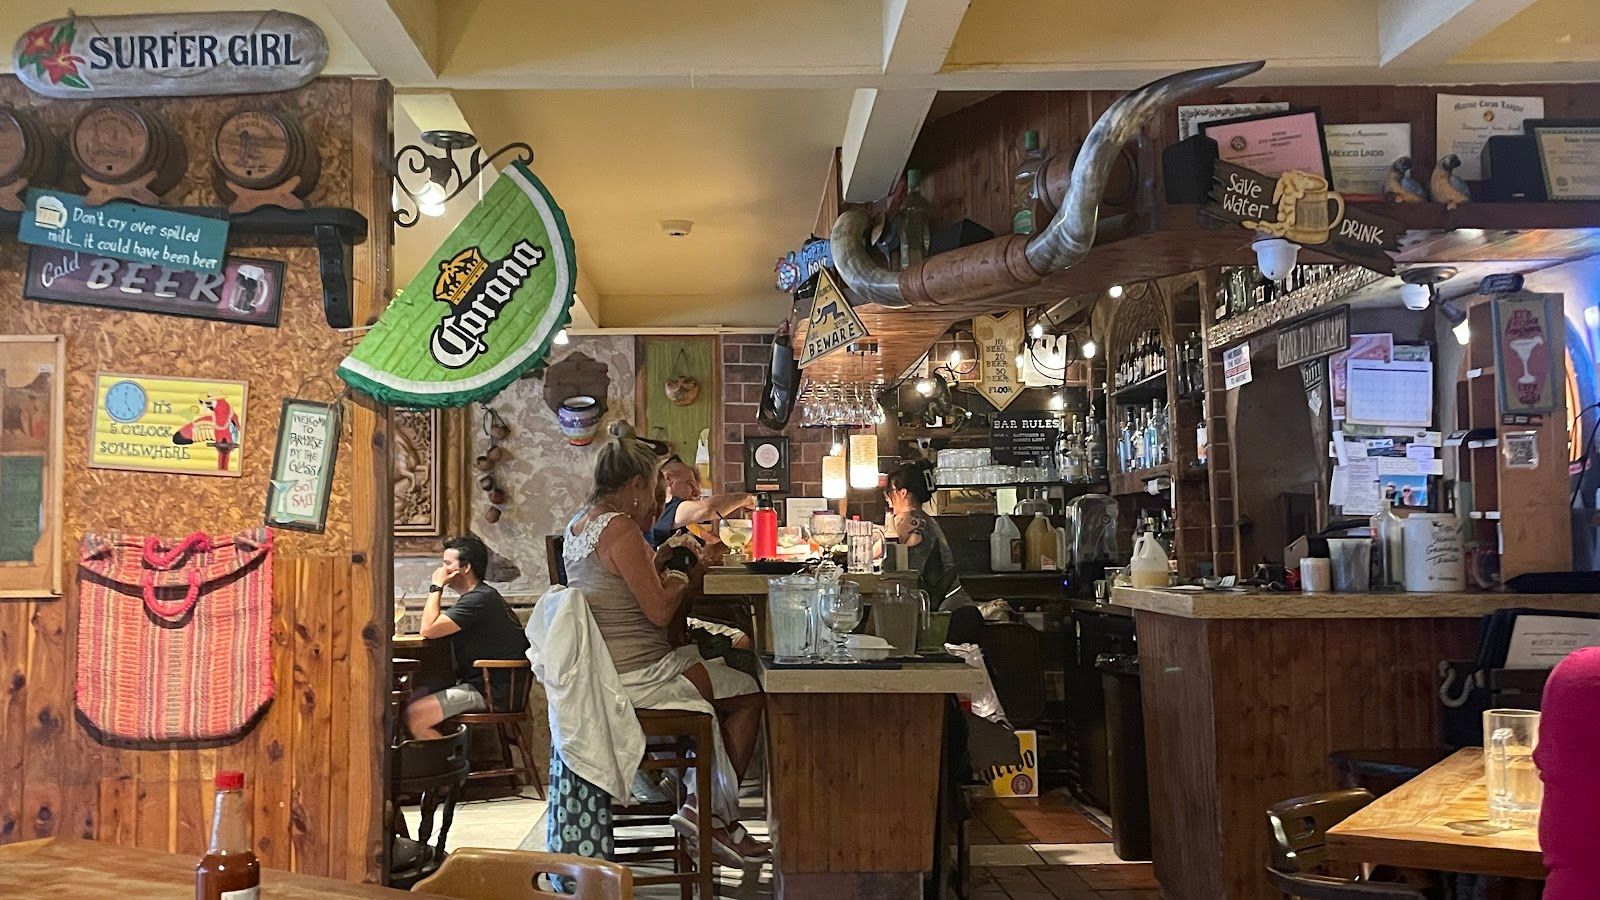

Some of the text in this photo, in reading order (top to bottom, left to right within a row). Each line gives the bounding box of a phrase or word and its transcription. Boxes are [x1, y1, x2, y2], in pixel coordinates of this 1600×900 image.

[90, 32, 302, 70] SURFER GIRL
[1226, 173, 1262, 199] Save
[73, 206, 200, 243] Don't cry over spilled
[1340, 219, 1383, 245] DRINK
[83, 233, 93, 249] it
[97, 237, 130, 255] could
[133, 241, 160, 260] have
[162, 246, 190, 265] been
[192, 251, 218, 269] beer
[41, 252, 225, 302] Cold BEER
[431, 239, 544, 368] Corona
[808, 322, 856, 357] BEWARE
[110, 423, 118, 434] 5
[994, 419, 1059, 428] BAR RULES
[100, 440, 191, 460] SOMEWHERE
[290, 448, 319, 462] BY THE
